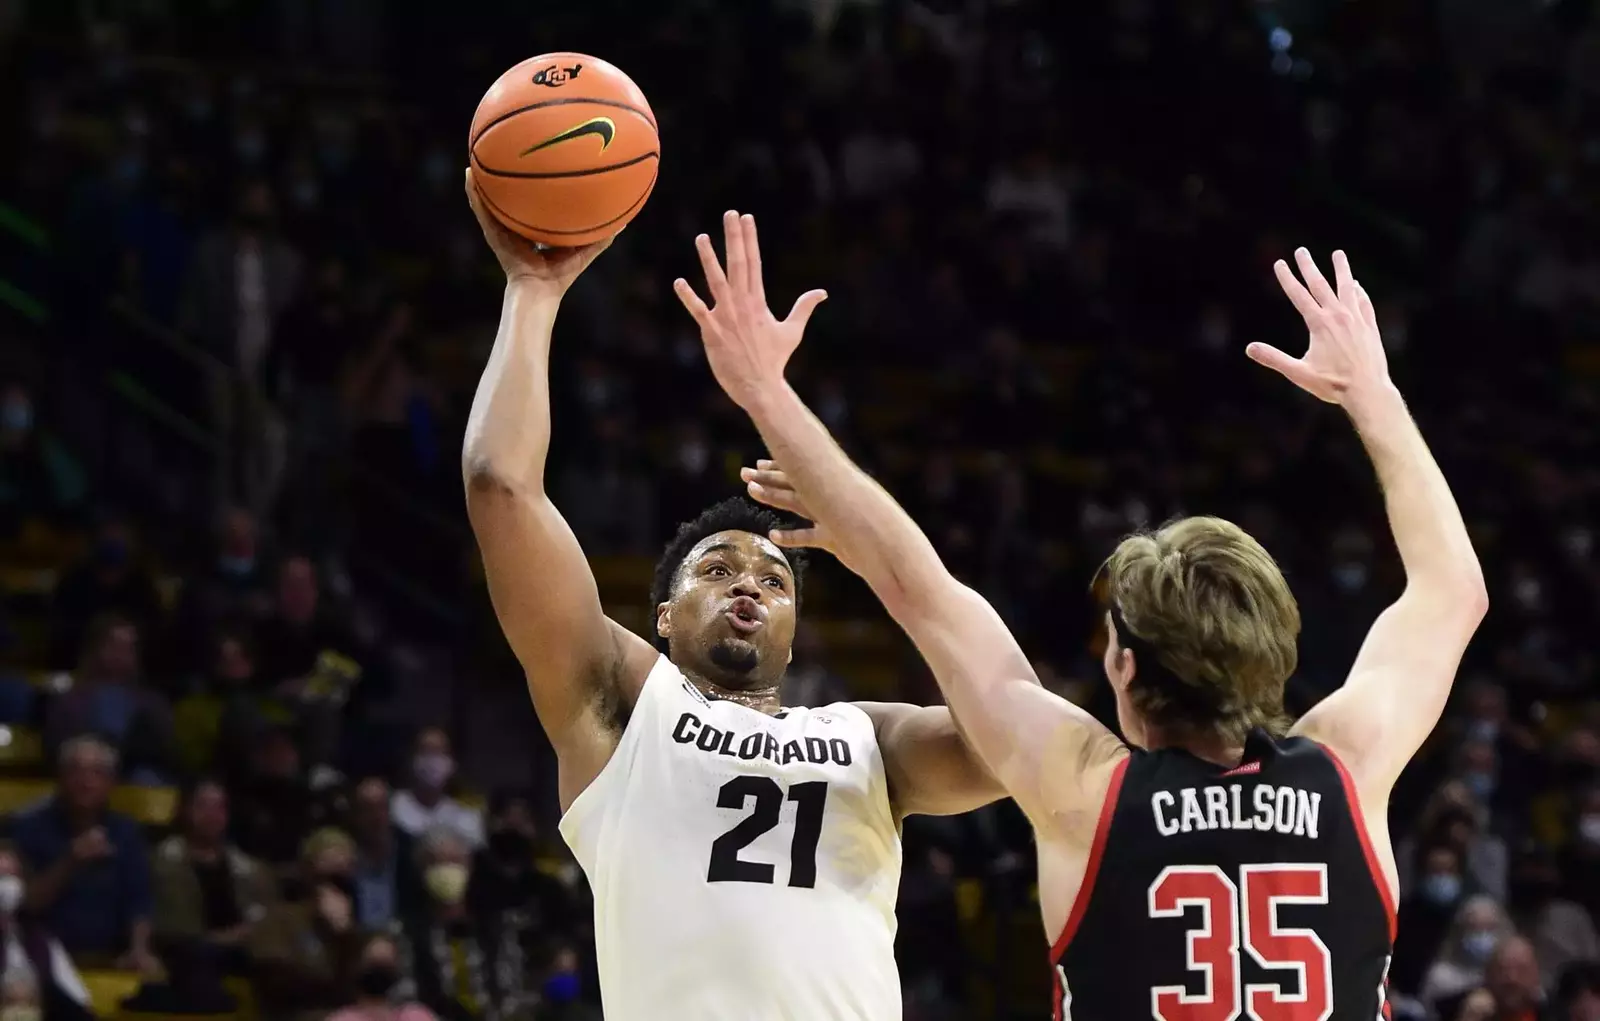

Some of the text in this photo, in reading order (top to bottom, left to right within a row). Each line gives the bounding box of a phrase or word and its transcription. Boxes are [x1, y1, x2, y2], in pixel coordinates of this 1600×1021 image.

[672, 712, 852, 767] COLORADO
[706, 775, 829, 889] 21
[1151, 783, 1322, 839] CARLSON
[1148, 863, 1334, 1021] 35
